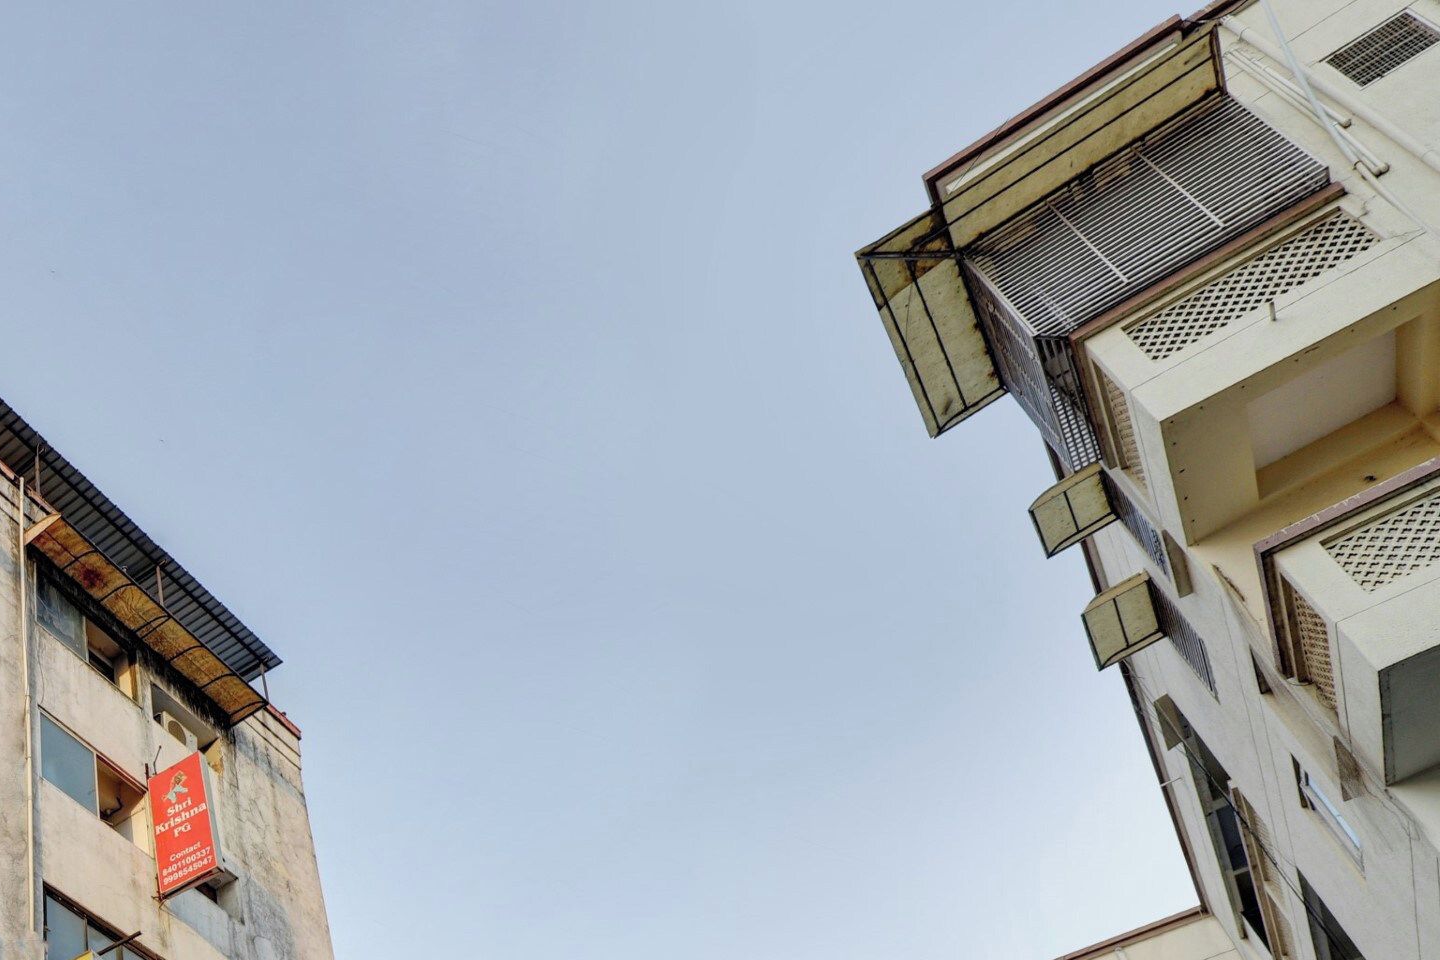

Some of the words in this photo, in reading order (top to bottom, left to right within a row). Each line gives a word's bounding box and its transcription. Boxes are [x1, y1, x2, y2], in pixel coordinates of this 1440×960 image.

[166, 797, 192, 817] Shri
[155, 802, 207, 836] Krishna
[173, 822, 192, 838] PG
[170, 841, 201, 862] Contact
